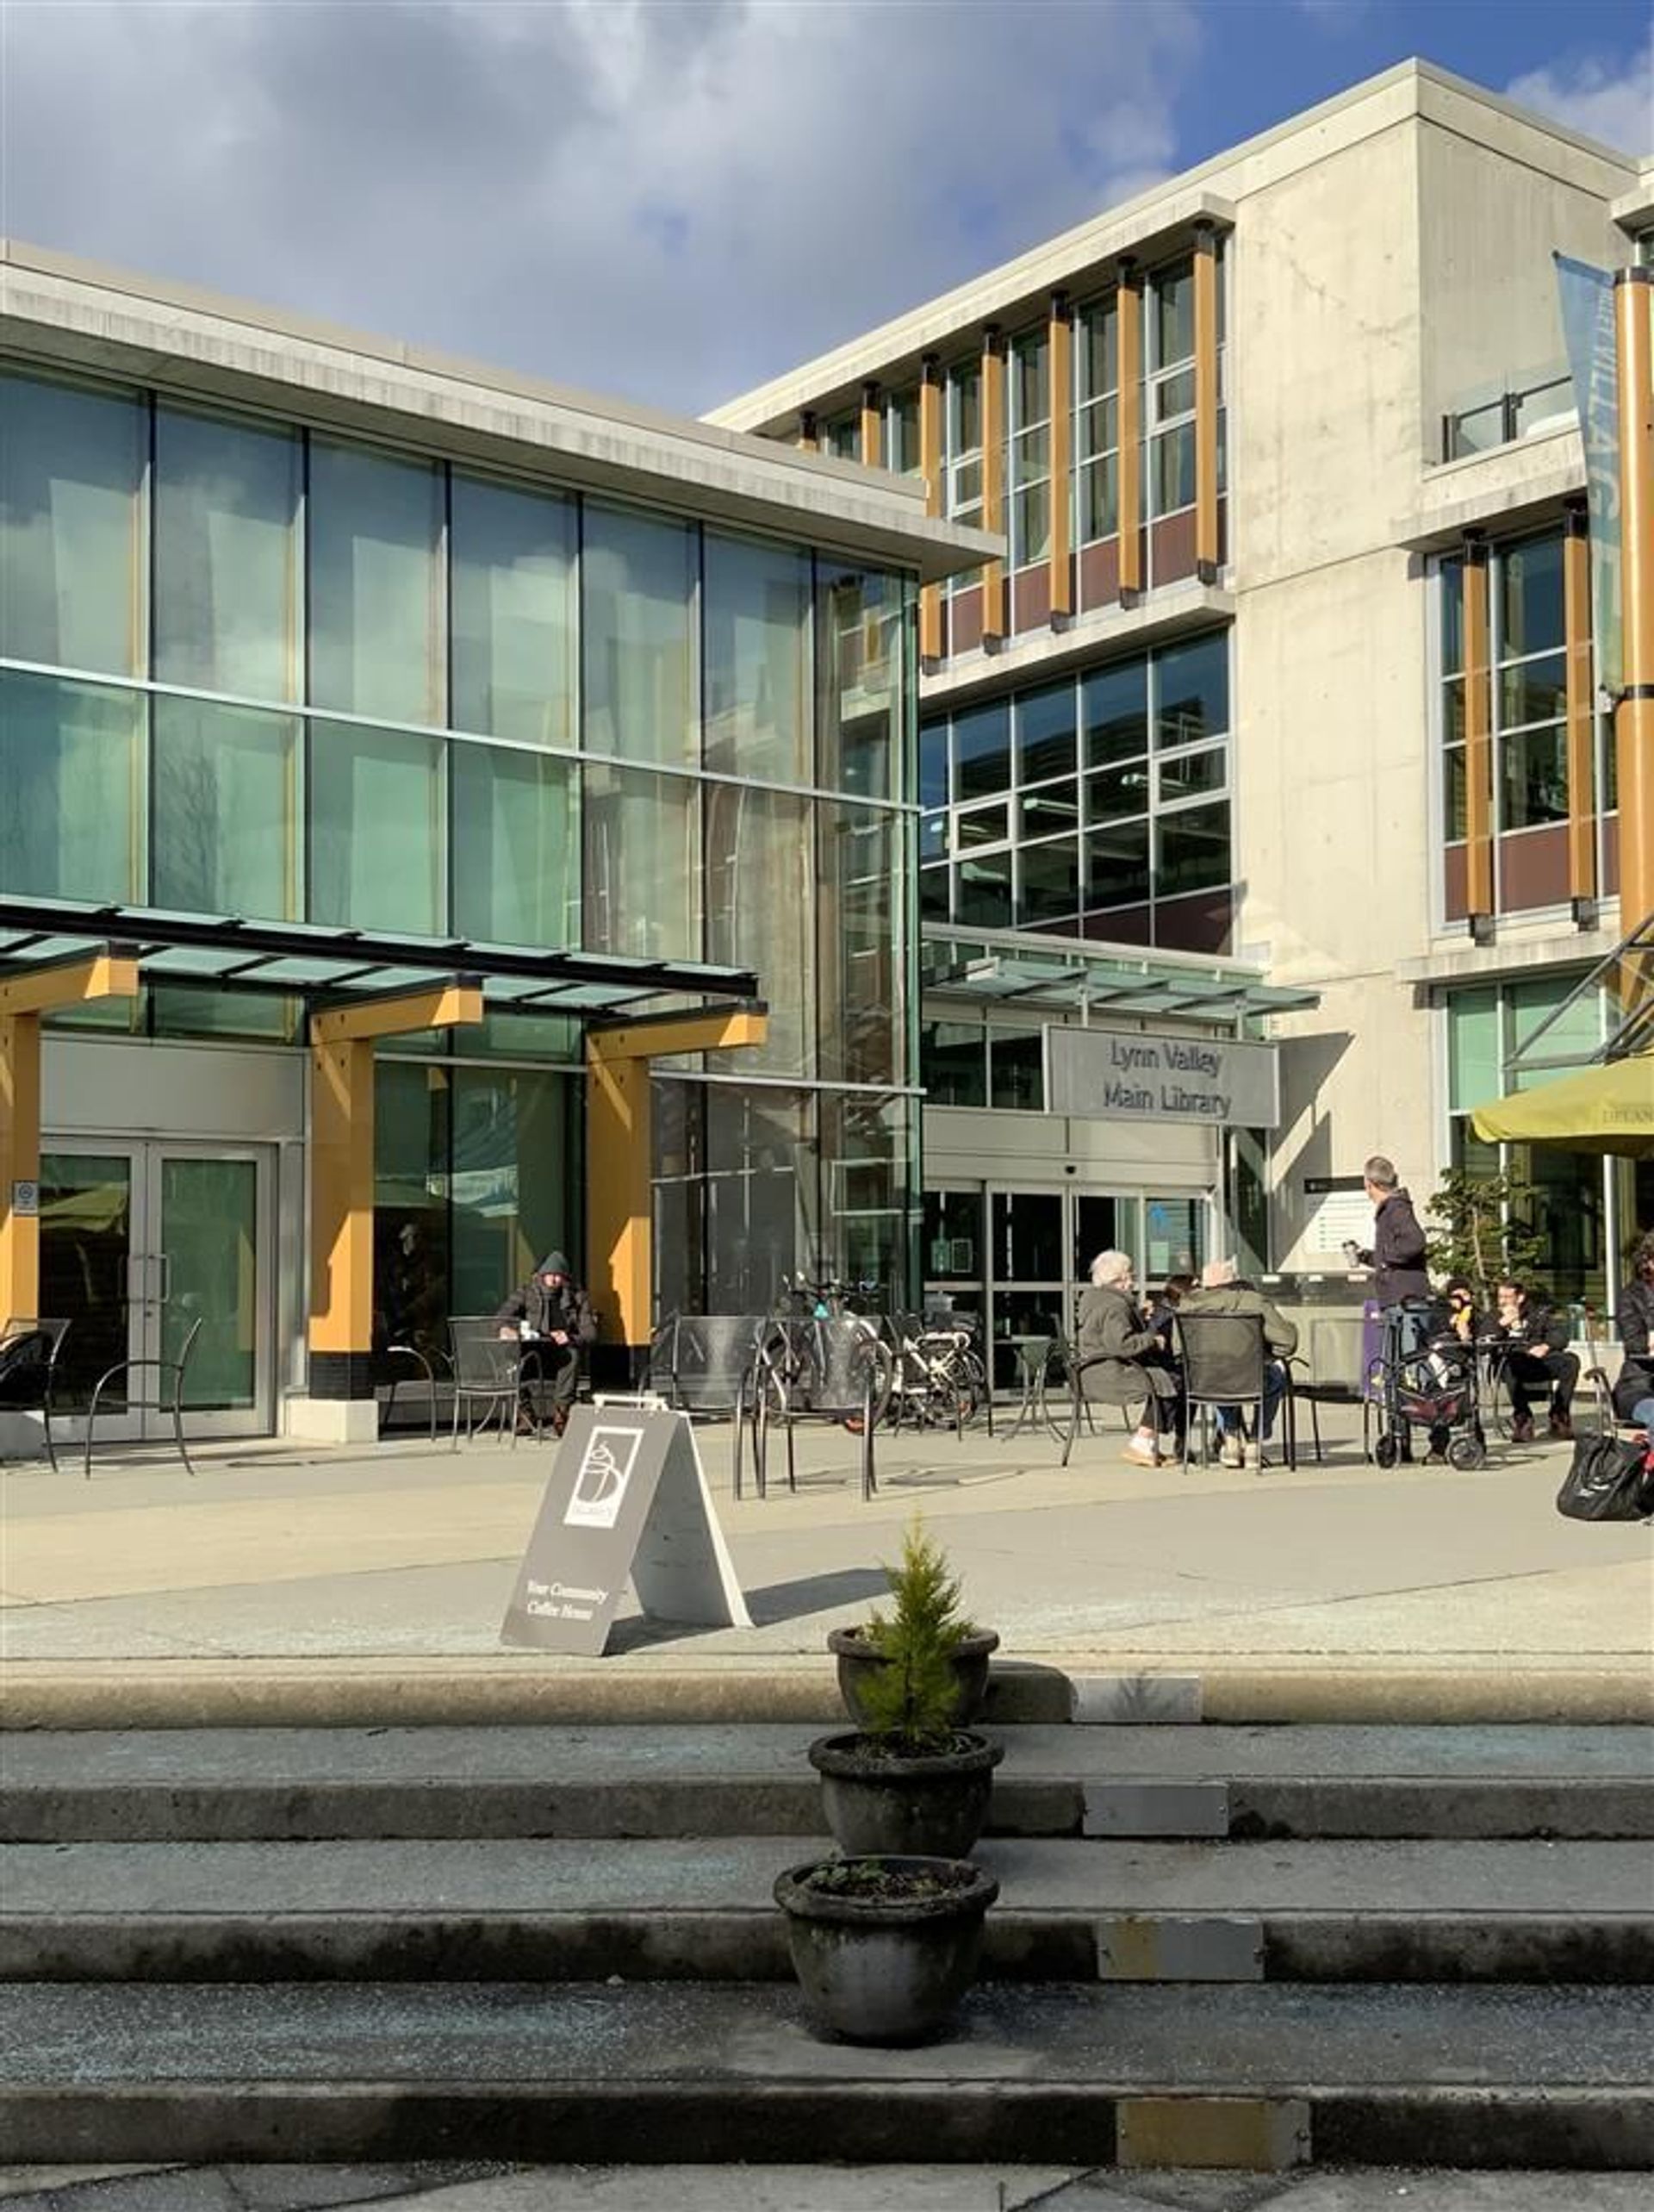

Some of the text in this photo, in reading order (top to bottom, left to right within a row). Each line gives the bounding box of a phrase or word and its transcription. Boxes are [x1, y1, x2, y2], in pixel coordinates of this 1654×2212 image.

[1110, 1039, 1222, 1078] Lynn Valley
[1104, 1081, 1231, 1118] Main Library
